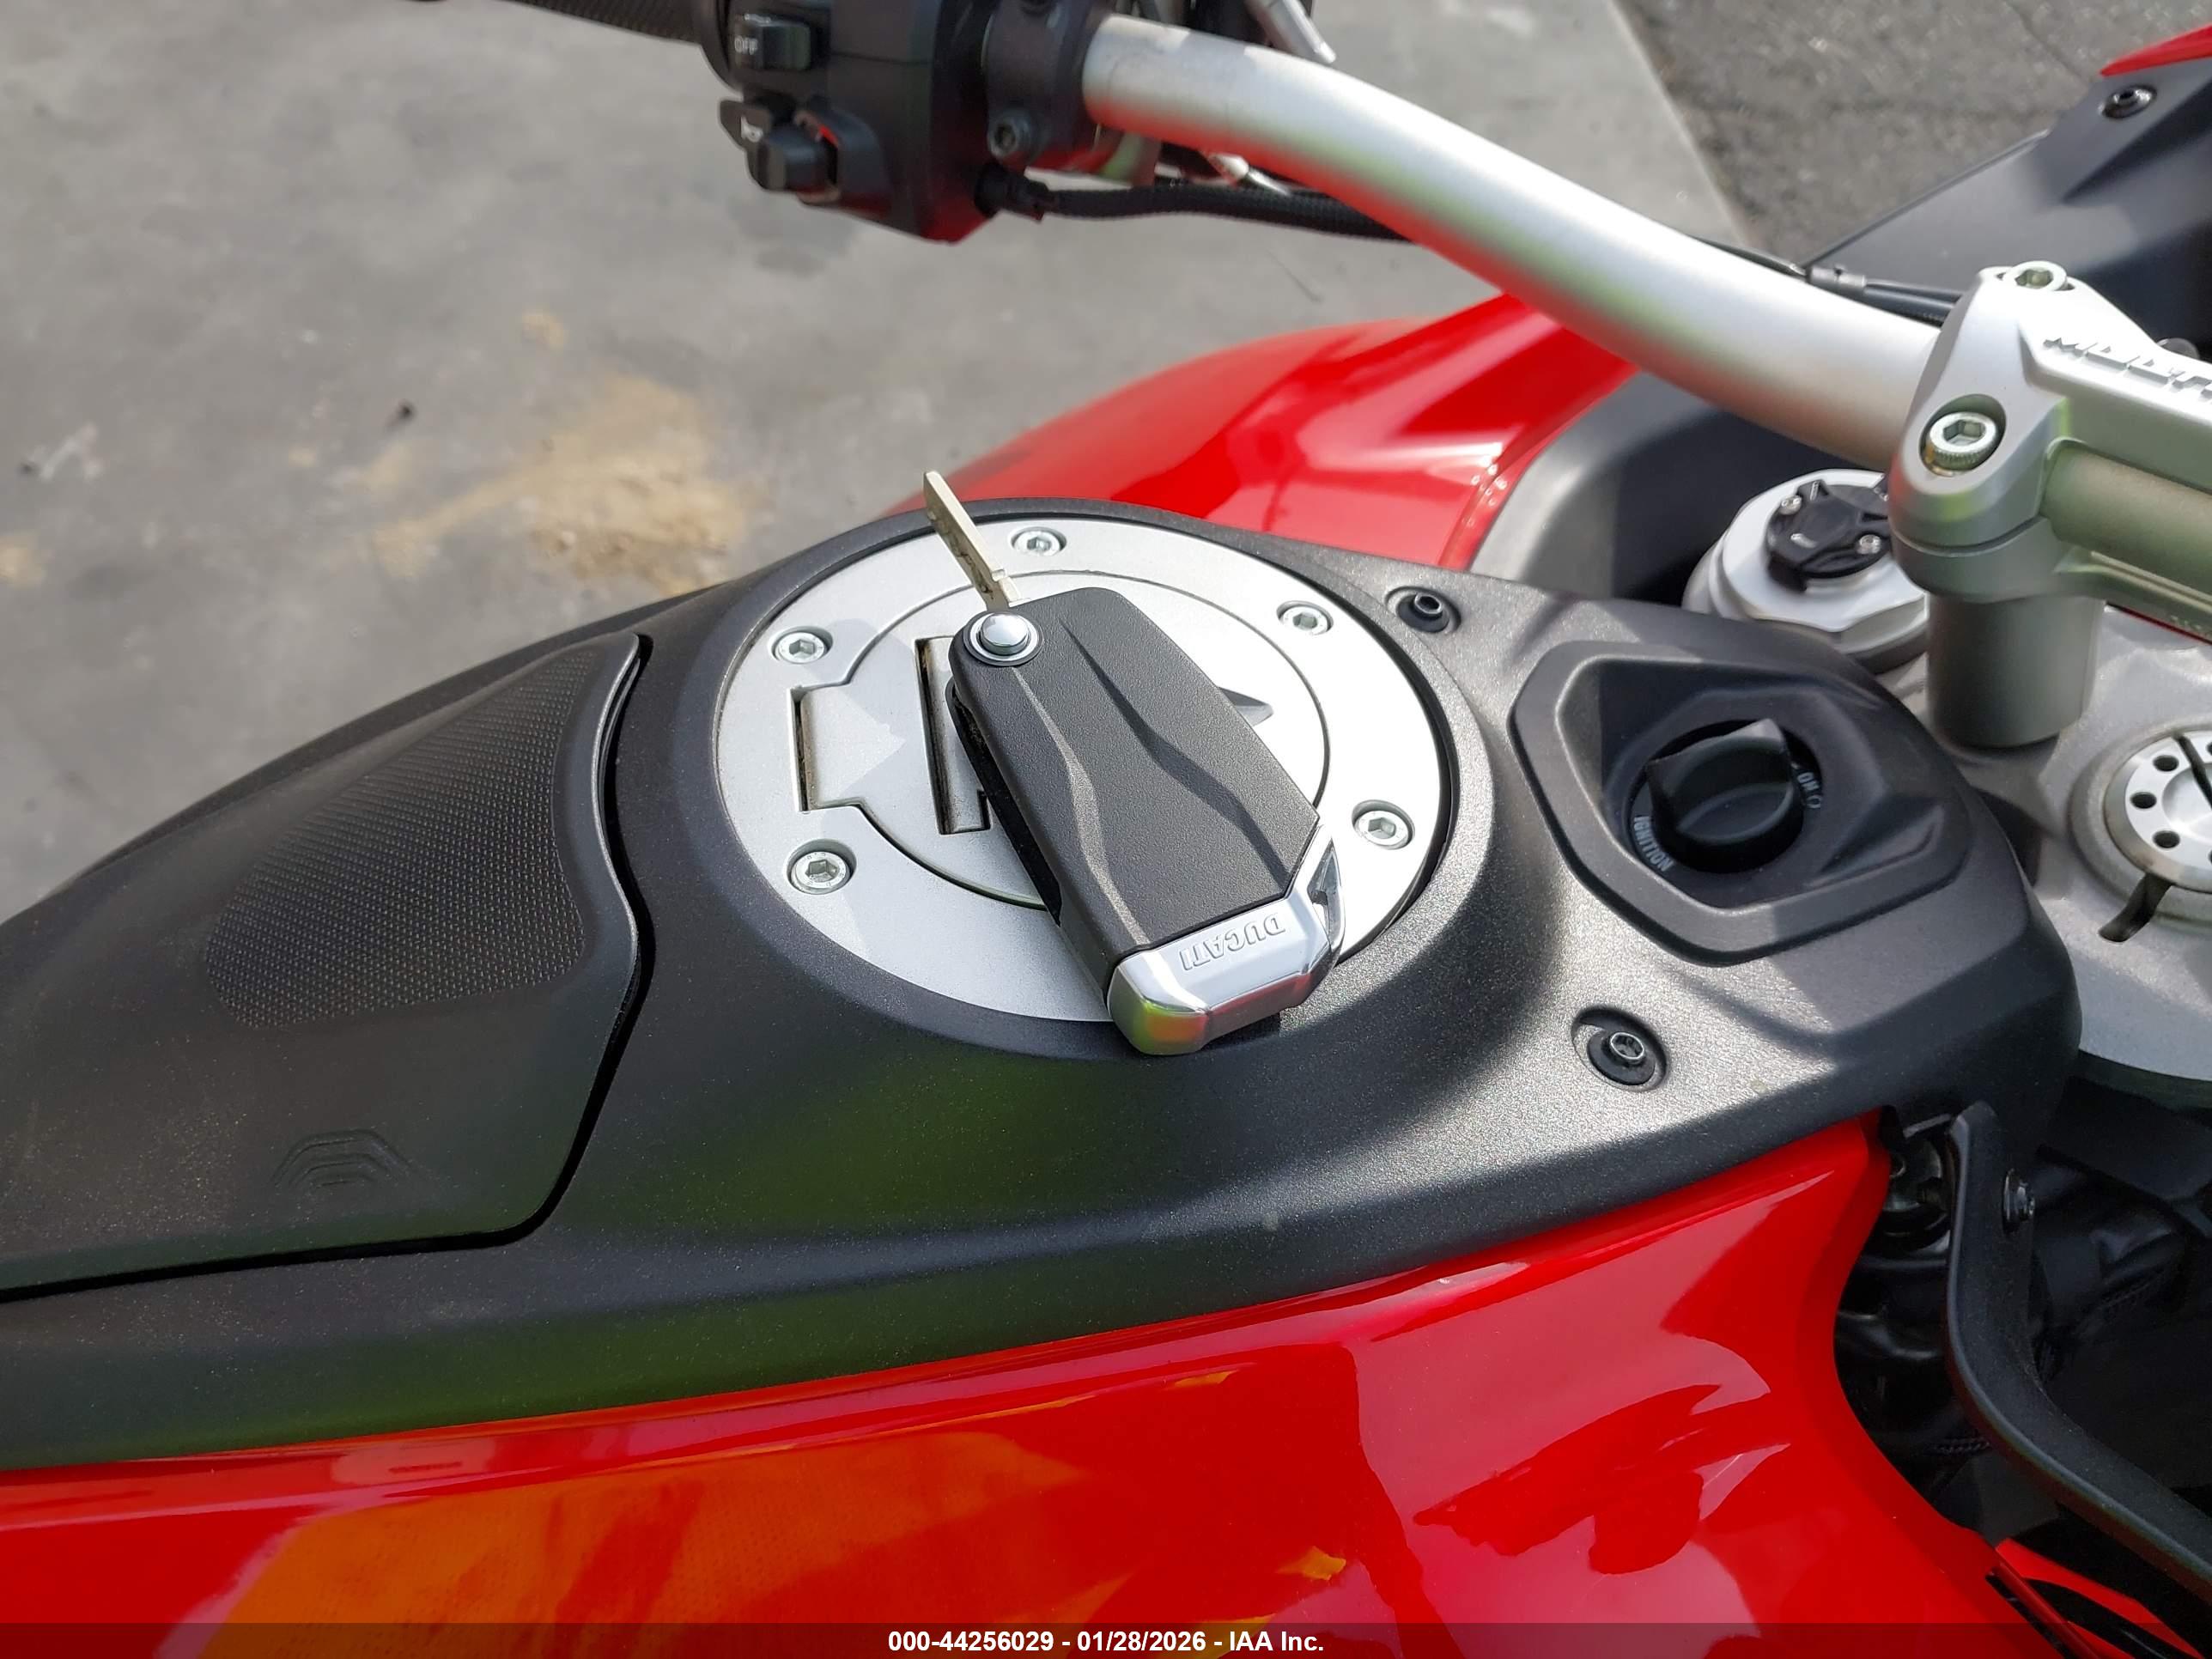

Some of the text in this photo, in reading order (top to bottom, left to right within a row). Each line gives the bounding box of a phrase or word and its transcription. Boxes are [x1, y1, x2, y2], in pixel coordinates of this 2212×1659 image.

[734, 36, 758, 55] OFF
[1634, 816, 1674, 872] IGNITION
[1180, 914, 1285, 970] DUCATI
